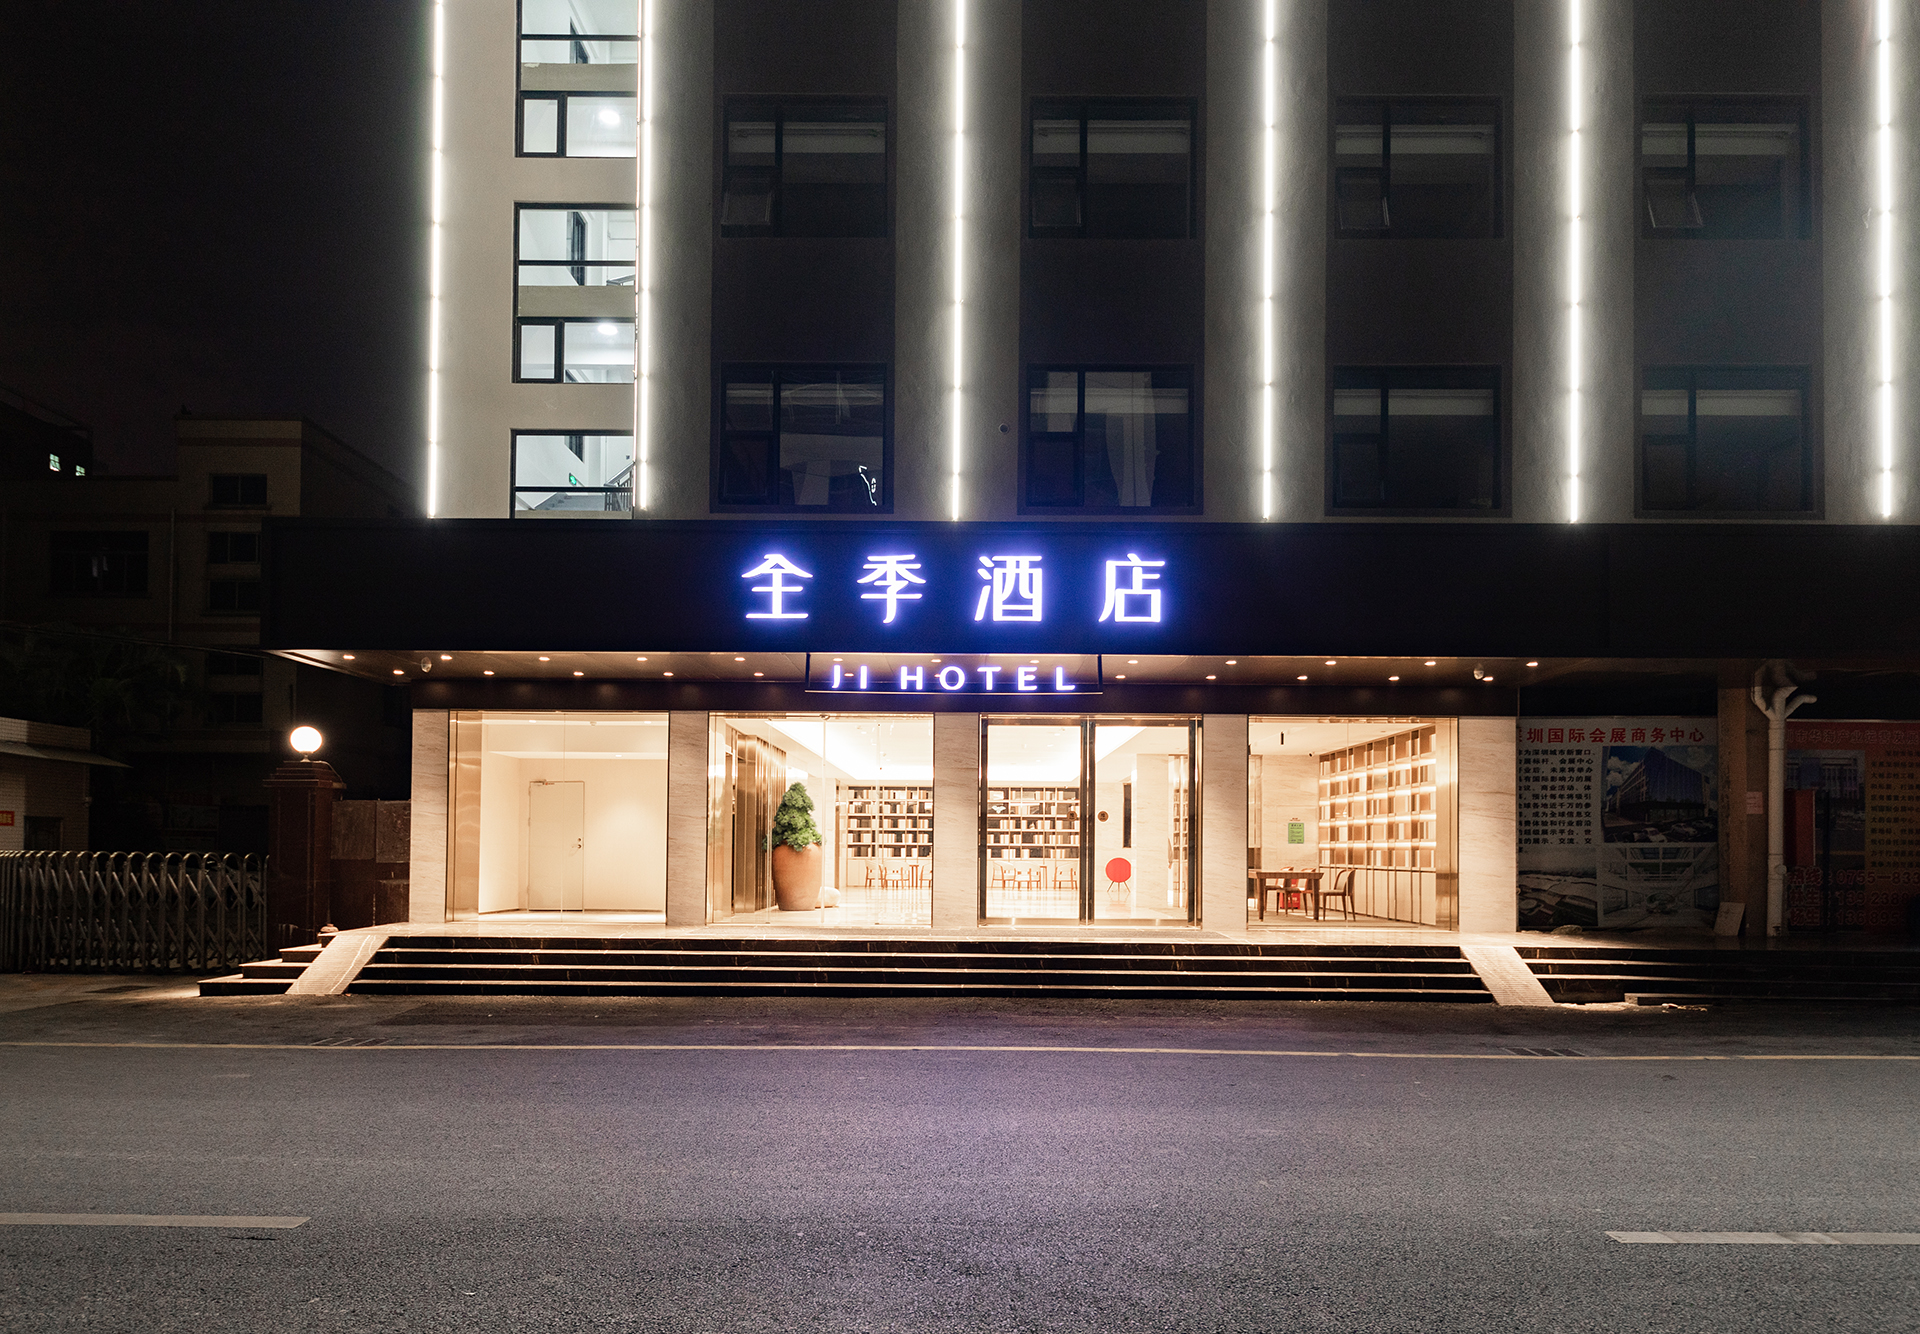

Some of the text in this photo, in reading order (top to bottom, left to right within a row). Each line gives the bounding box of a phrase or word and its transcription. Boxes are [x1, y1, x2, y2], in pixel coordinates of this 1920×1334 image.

[741, 553, 1166, 624] 全季酒店
[831, 664, 1076, 692] JI HOTEL
[1518, 727, 1705, 744] 圳国际会展商务中心
